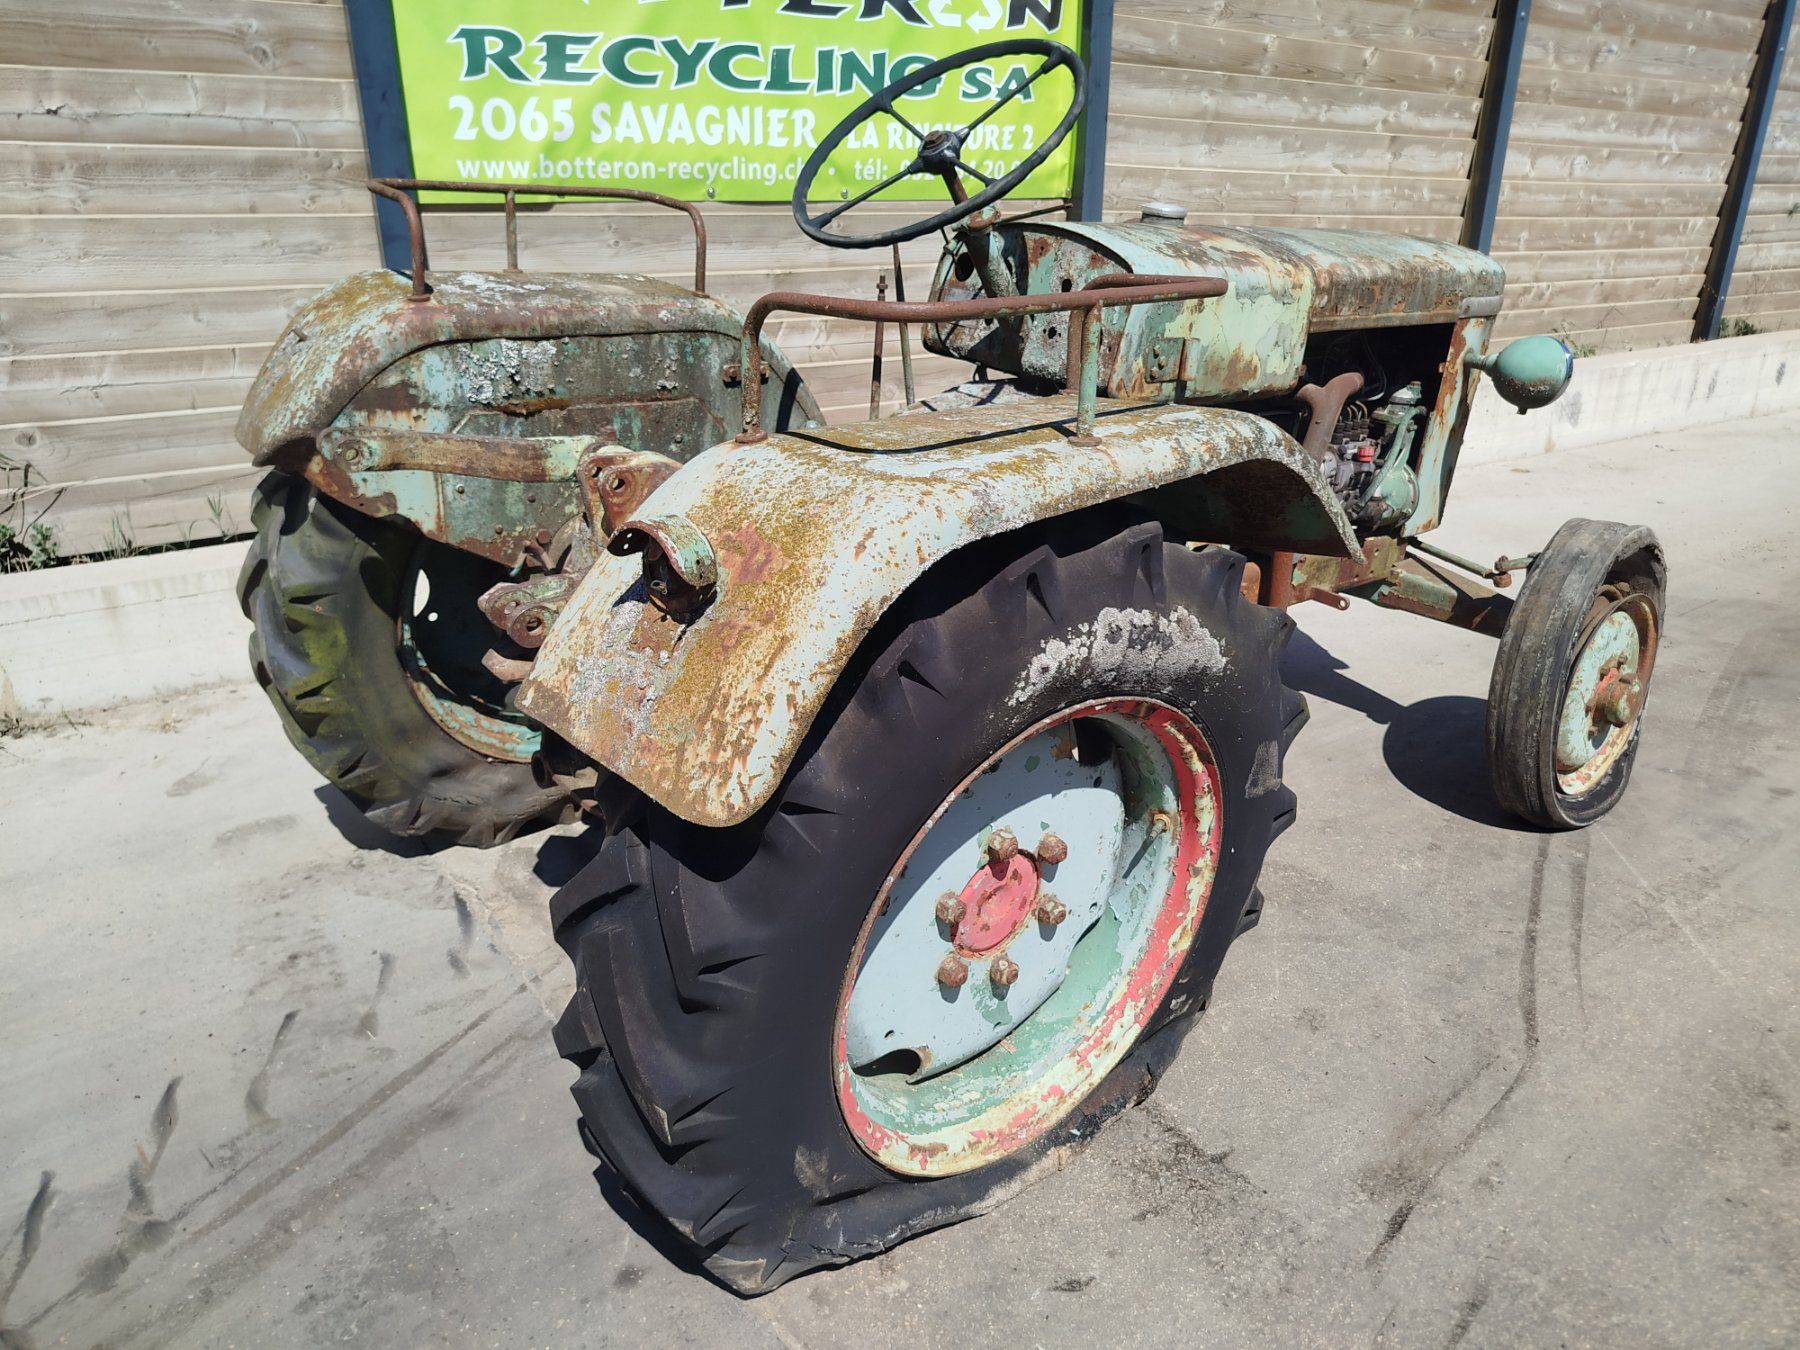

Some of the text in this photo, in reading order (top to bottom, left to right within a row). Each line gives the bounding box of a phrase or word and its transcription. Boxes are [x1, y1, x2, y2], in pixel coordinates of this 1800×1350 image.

[447, 25, 1034, 103] RECYCLING SA
[449, 95, 1034, 151] 2065 SAVAGNIER LA RINURE 2
[854, 158, 888, 180] tél:
